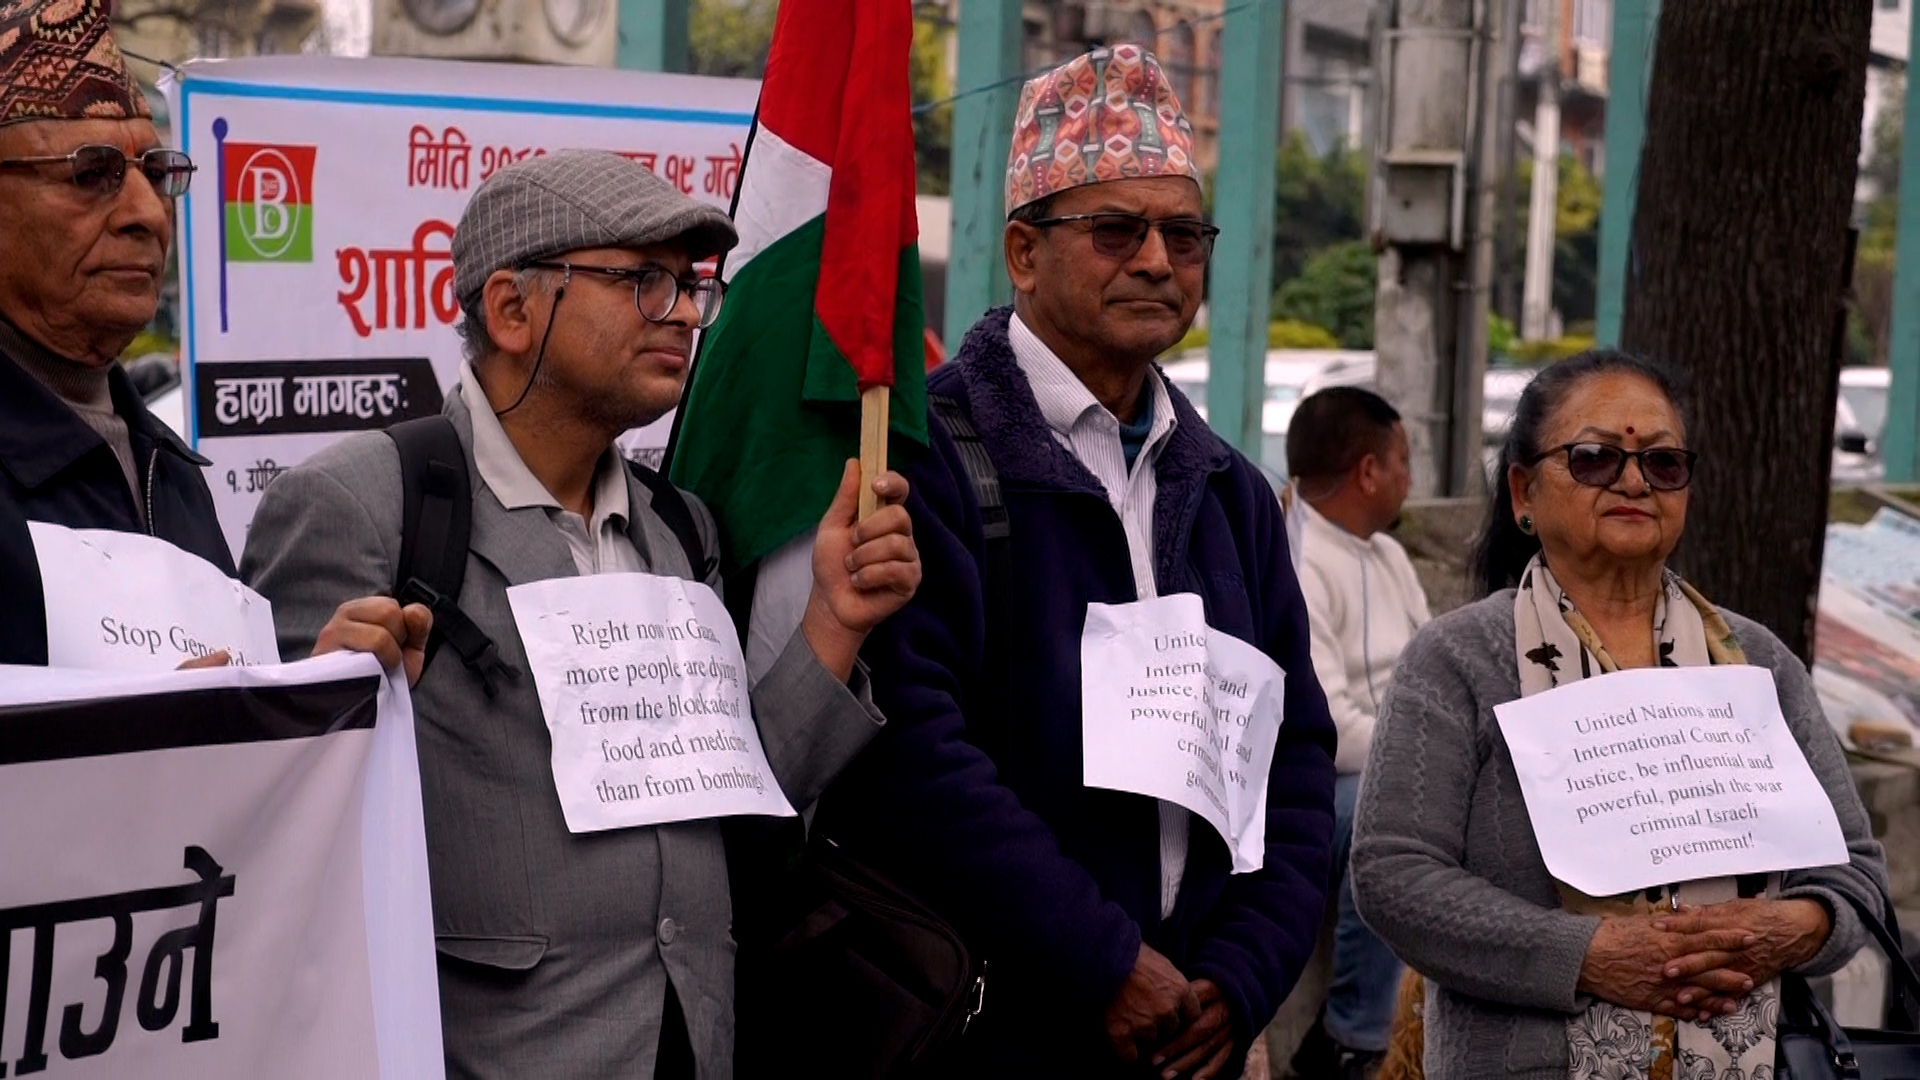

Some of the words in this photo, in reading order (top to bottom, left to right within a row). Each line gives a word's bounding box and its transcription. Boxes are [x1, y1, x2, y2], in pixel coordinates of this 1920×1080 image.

[408, 124, 472, 189] मिति
[248, 166, 289, 239] B
[214, 377, 285, 426] हाम्रा
[100, 616, 162, 655] Stop
[169, 626, 261, 667] Genid
[571, 620, 630, 650] Right
[636, 623, 665, 640] now
[665, 618, 685, 641] in
[566, 665, 620, 686] more
[625, 654, 681, 687] people
[683, 660, 706, 678] are
[1154, 630, 1207, 653] Unite
[1219, 678, 1248, 699] and
[580, 700, 629, 725] from
[635, 696, 663, 720] the
[667, 692, 730, 718] blockade
[730, 696, 740, 719] of
[1127, 682, 1199, 701] Justice,
[1131, 707, 1210, 738] powerful,
[1236, 713, 1254, 729] of
[1574, 707, 1638, 735] United
[1640, 702, 1704, 721] Nations
[1706, 702, 1735, 720] and
[601, 736, 645, 763] food
[649, 734, 685, 759] and
[1573, 728, 1687, 763] International
[1689, 726, 1733, 744] Court
[1734, 727, 1751, 745] of
[596, 778, 641, 803] than
[644, 774, 696, 797] from
[1565, 768, 1634, 794] Justice,
[1635, 762, 1659, 779] be
[1663, 752, 1745, 774] influential
[1747, 754, 1774, 770] and
[1576, 788, 1665, 825] powerful,
[1668, 778, 1726, 806] punish
[1728, 778, 1753, 794] the
[1754, 781, 1784, 794] war
[1629, 808, 1702, 836] criminal
[1705, 802, 1759, 825] Israeli
[1649, 832, 1755, 866] government!
[0, 845, 236, 1080] ाउने
